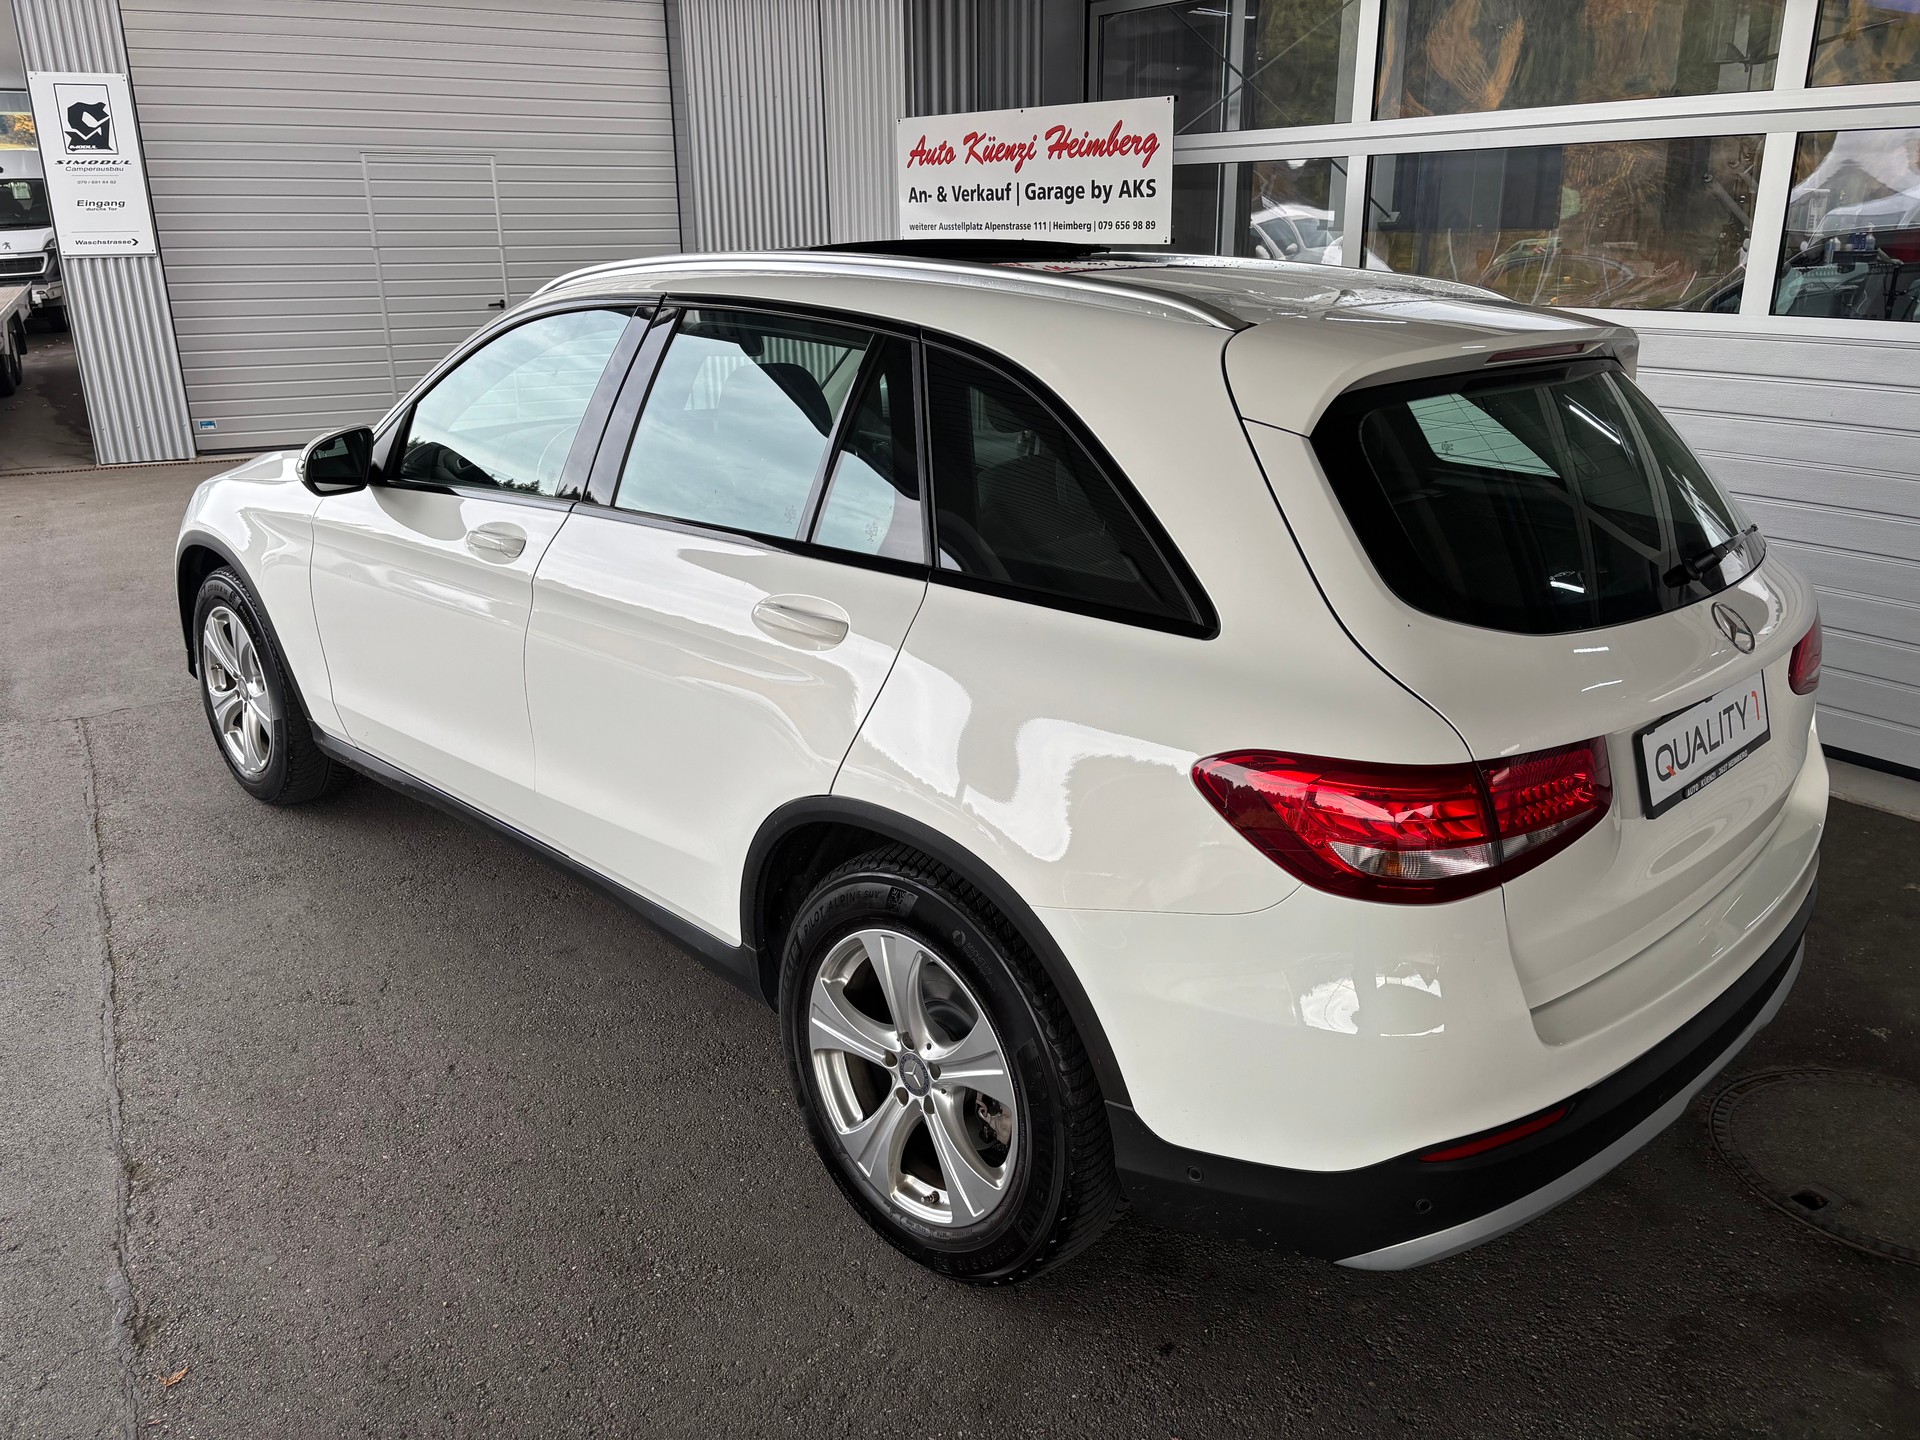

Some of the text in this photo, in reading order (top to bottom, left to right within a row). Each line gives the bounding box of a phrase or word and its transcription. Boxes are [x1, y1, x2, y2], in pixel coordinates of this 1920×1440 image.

[907, 119, 1160, 174] Auto Küenzi Heimberg
[76, 199, 126, 208] Eingang
[908, 186, 933, 203] An-
[936, 185, 948, 203] &
[951, 182, 1012, 202] Verkauf
[1024, 182, 1085, 205] Garage
[1091, 180, 1113, 204] by
[1118, 178, 1157, 199] AKS
[909, 221, 937, 231] weiterer
[938, 221, 983, 232] Ausstellplatz
[984, 221, 1032, 232] Alpenstrasse
[1033, 221, 1047, 231] 111
[1052, 220, 1092, 232] Heimberg
[1098, 220, 1113, 230] 079
[1115, 220, 1131, 230] 656
[1132, 220, 1143, 230] 98
[1145, 220, 1156, 230] 89
[803, 906, 824, 935] PILOT
[864, 890, 880, 899] SUV
